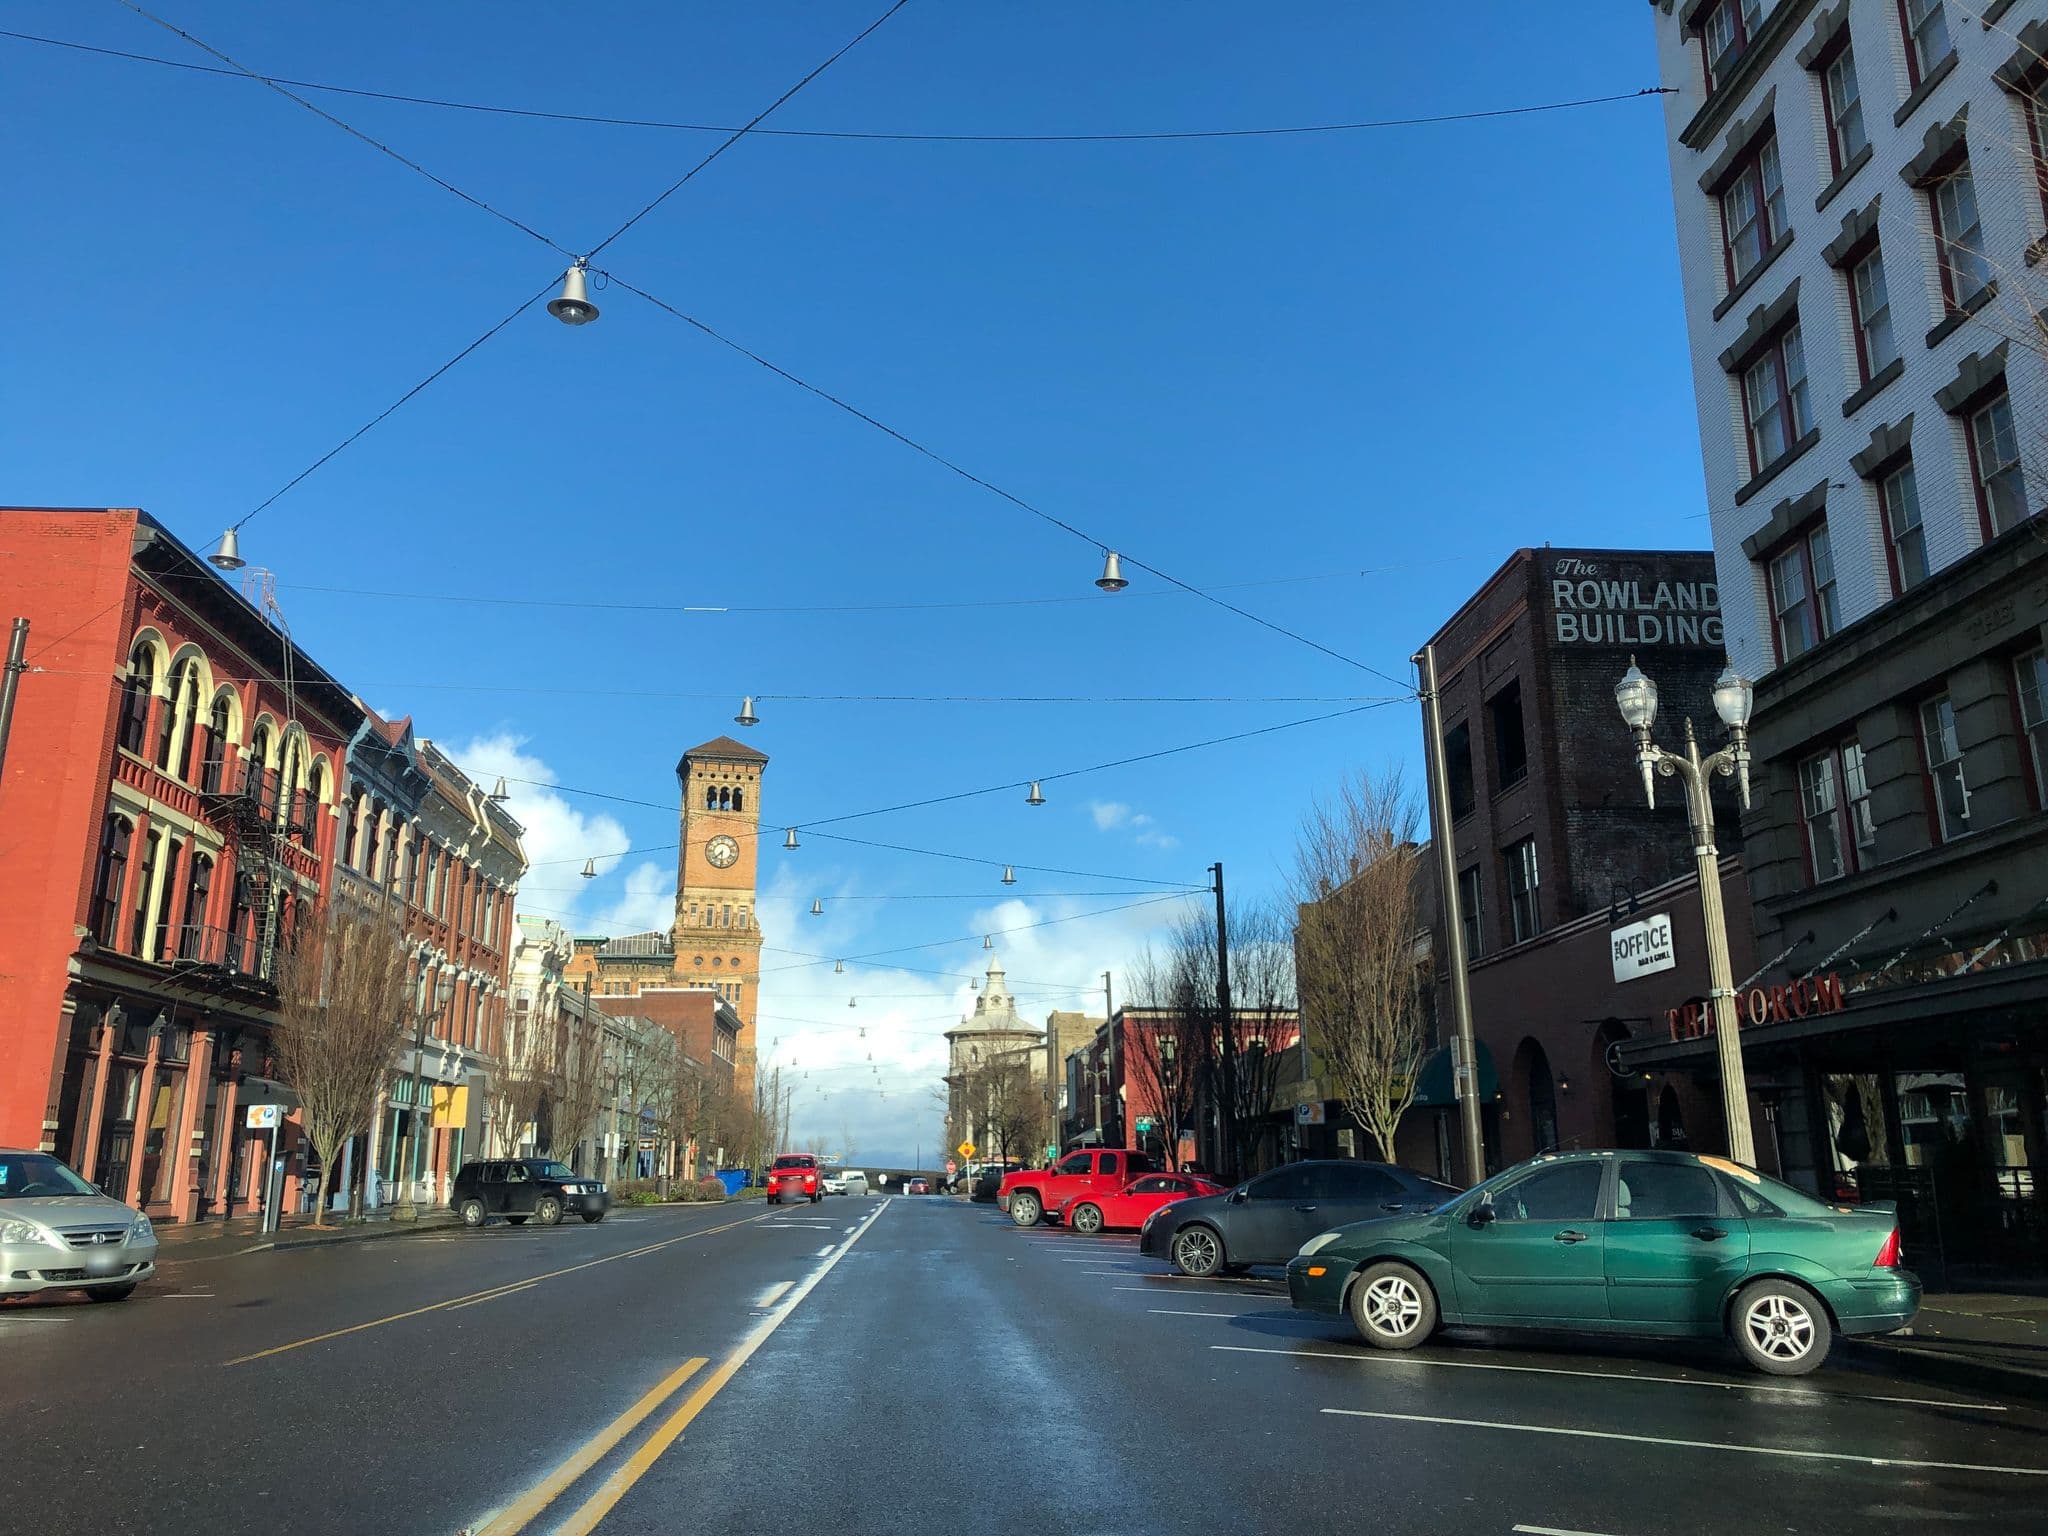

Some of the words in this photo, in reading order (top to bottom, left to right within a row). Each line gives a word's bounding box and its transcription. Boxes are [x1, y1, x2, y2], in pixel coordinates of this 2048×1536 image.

[1555, 558, 1598, 575] The
[1552, 579, 1721, 611] ROWLAND
[1556, 613, 1725, 645] BUILDING
[1620, 925, 1668, 958] OFFICE
